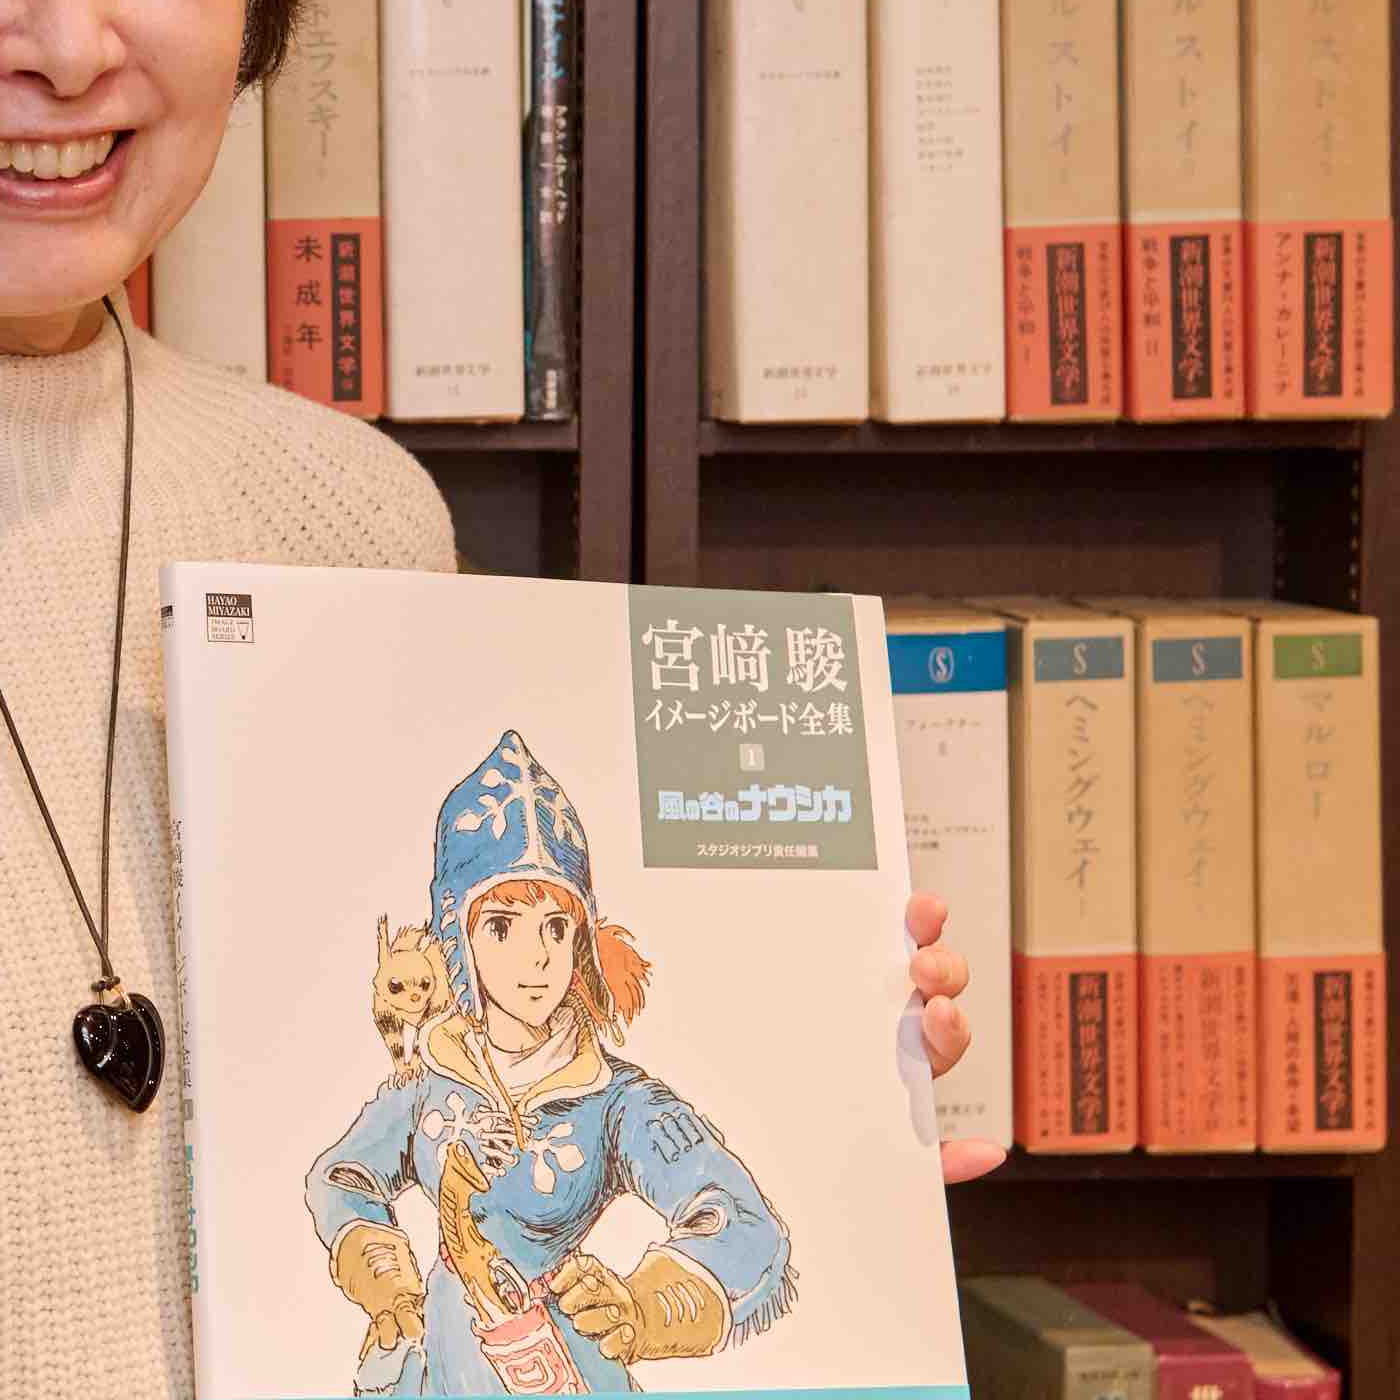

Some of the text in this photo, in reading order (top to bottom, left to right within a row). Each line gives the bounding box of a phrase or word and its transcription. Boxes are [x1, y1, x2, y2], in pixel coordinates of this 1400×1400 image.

[294, 235, 324, 353] 未成年
[1053, 245, 1085, 384] 新潮世界文学
[1177, 239, 1208, 380] 新潮世界文学
[1307, 235, 1341, 384] 新潮世界文学
[207, 595, 238, 606] HAYAO
[208, 606, 250, 617] MIYAZAKI
[1073, 643, 1088, 674] S
[1191, 642, 1207, 674] S
[645, 699, 855, 736] イメージボード全集
[1302, 691, 1340, 820] マルロー
[656, 783, 853, 824] 風の谷のナウシカ
[1064, 694, 1101, 890] ヘミングウェイ
[1180, 694, 1216, 889] ヘミングウェイ
[695, 843, 820, 859] スタジオジブリ責任編集
[1078, 975, 1106, 1120] 新潮世界文学
